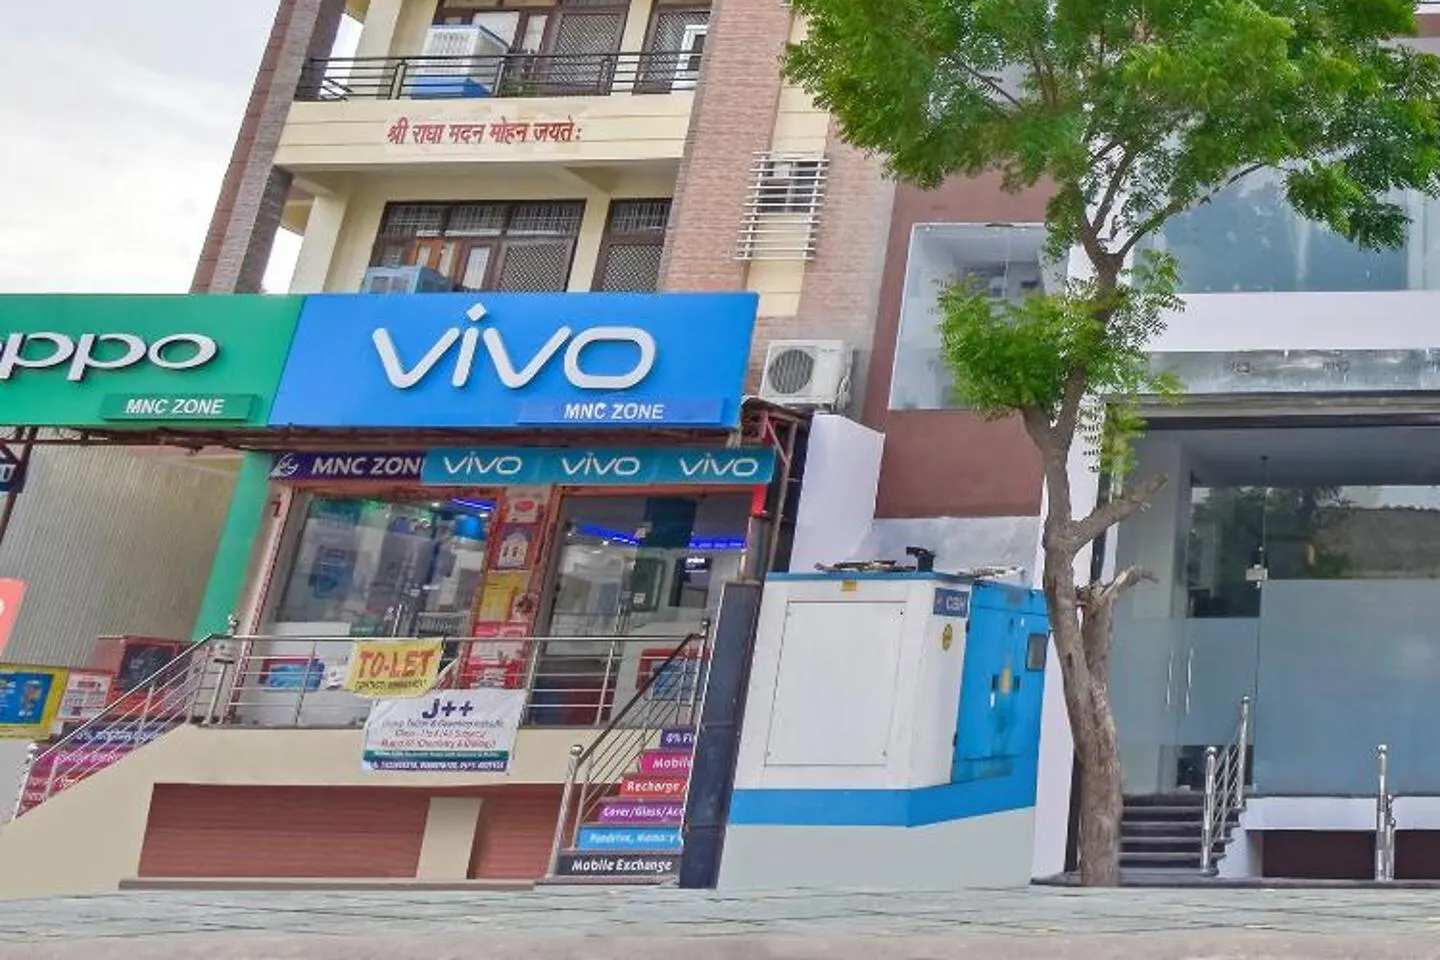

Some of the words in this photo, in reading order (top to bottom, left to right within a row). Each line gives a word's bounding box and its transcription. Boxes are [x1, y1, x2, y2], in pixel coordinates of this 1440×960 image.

[387, 117, 408, 144] श्री
[413, 124, 445, 143] राधा
[450, 124, 485, 143] मदन
[490, 116, 530, 144] मोहन
[0, 331, 216, 381] ppo
[372, 303, 656, 389] vivo
[126, 399, 168, 414] MNC
[172, 399, 225, 415] ZONE
[564, 403, 607, 420] MNC
[611, 403, 664, 420] ZONE
[311, 456, 366, 475] MNC
[370, 456, 425, 475] ZON
[444, 451, 522, 475] vivo
[562, 452, 640, 476] vivo
[680, 453, 758, 477] vivo
[358, 648, 435, 678] TO-LET
[422, 699, 474, 719] J++
[627, 781, 680, 794] Recharge
[571, 858, 614, 871] Mobile
[616, 859, 672, 872] Exchange
